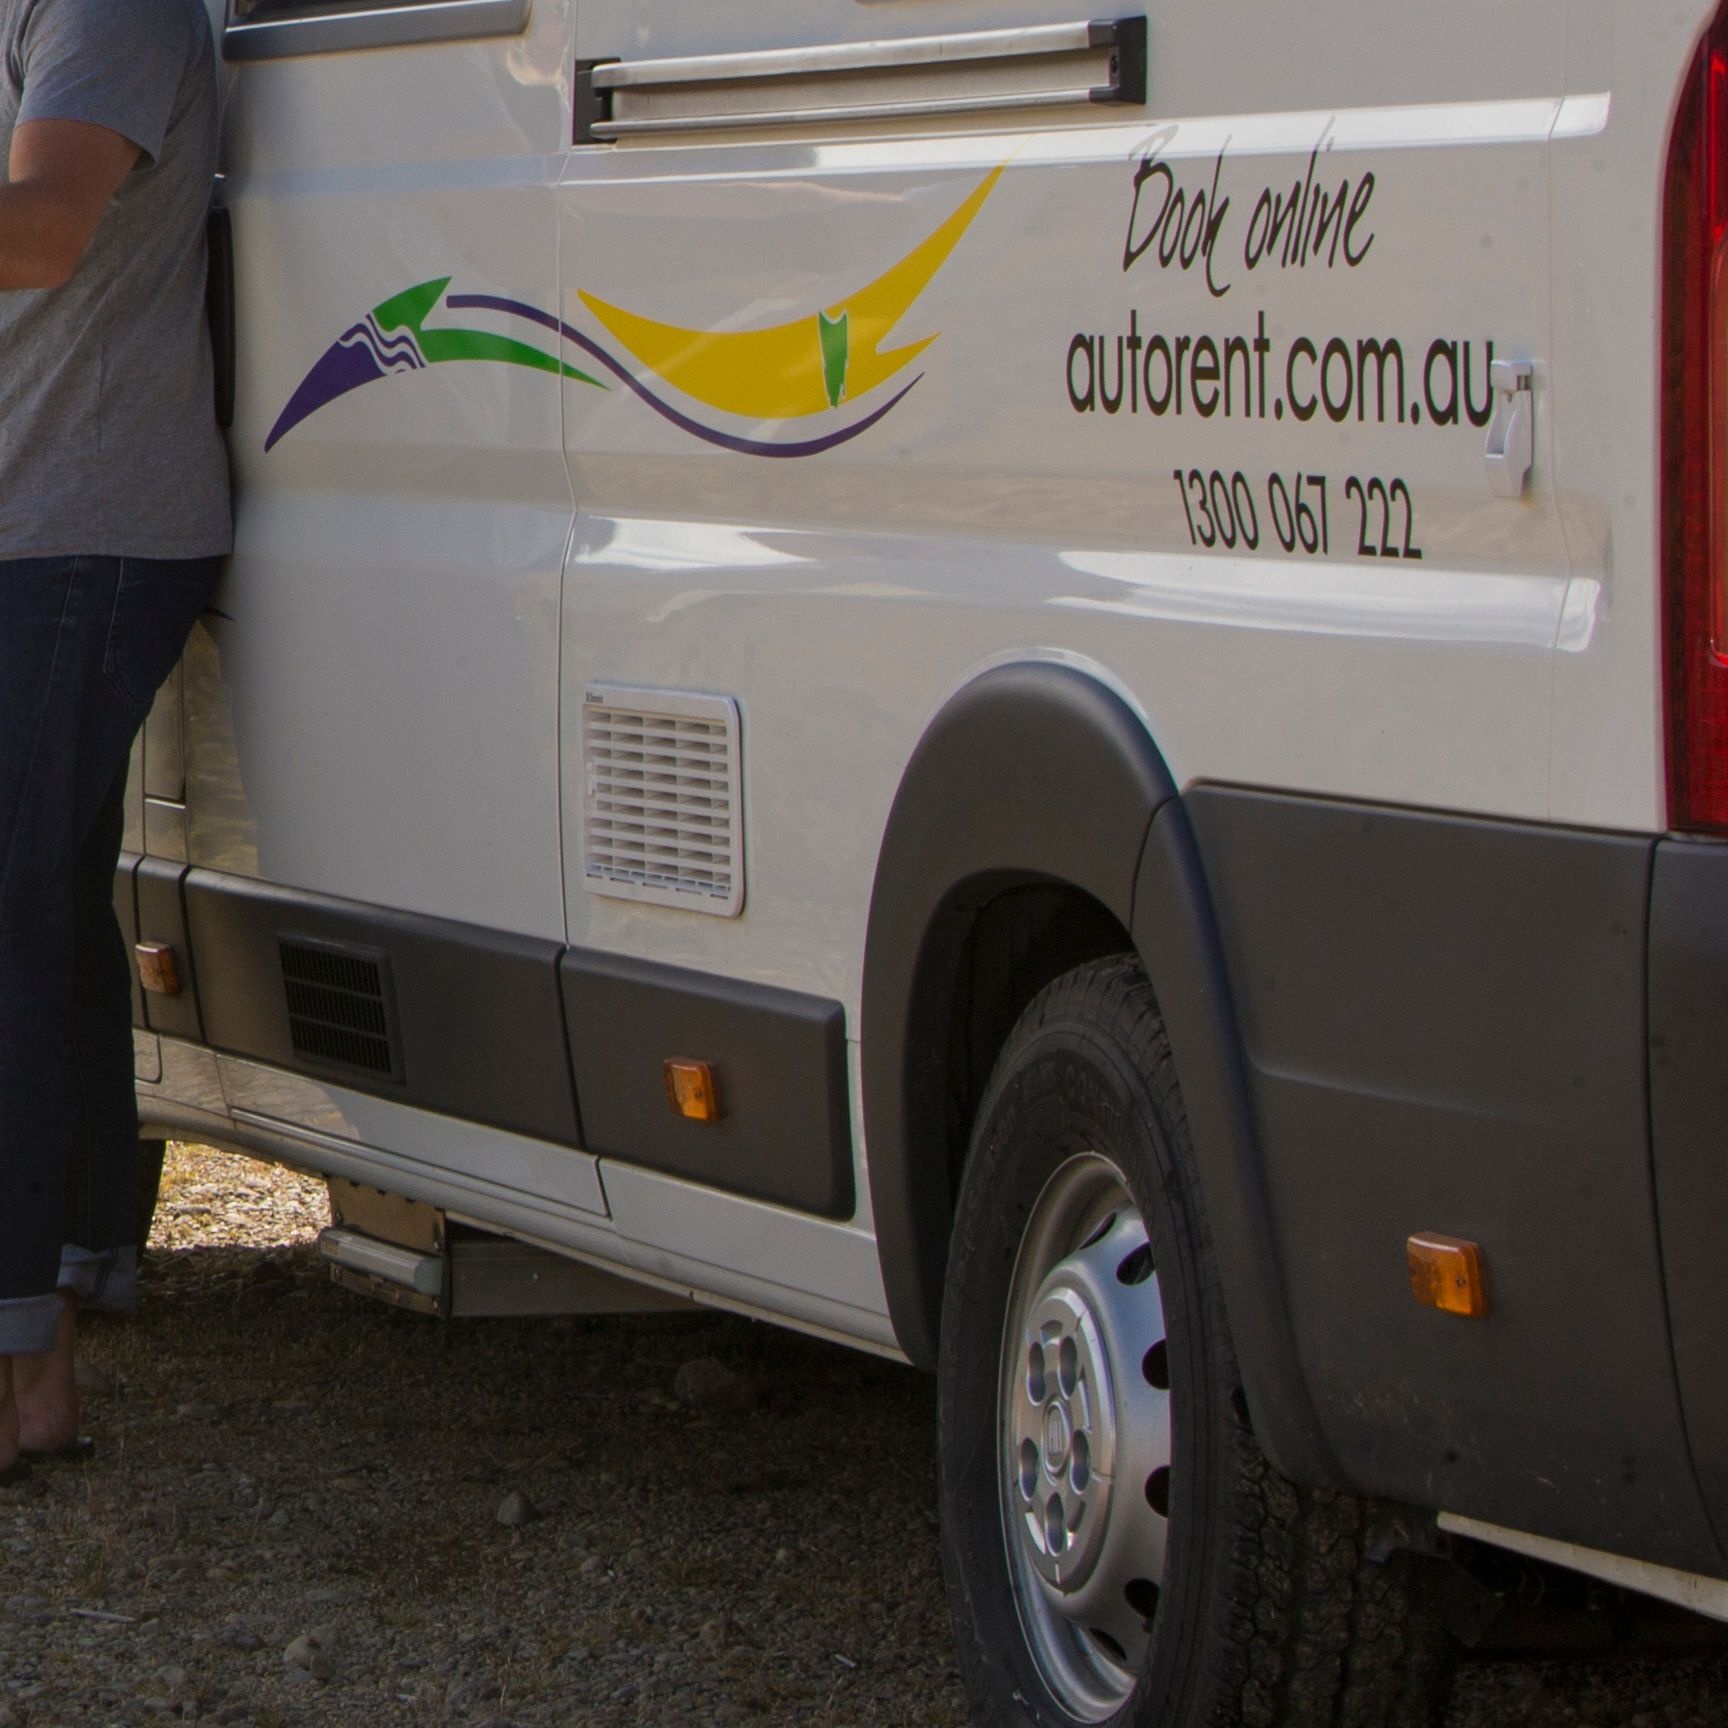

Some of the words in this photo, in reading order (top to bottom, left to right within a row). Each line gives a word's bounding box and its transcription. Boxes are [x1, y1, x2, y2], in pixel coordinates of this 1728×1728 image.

[1122, 123, 1231, 298] Book
[1244, 115, 1376, 271] online
[1065, 309, 1494, 427] autorent.com.au
[1172, 468, 1260, 551] 1300
[1266, 471, 1330, 556] 067
[1344, 475, 1423, 560] 222
